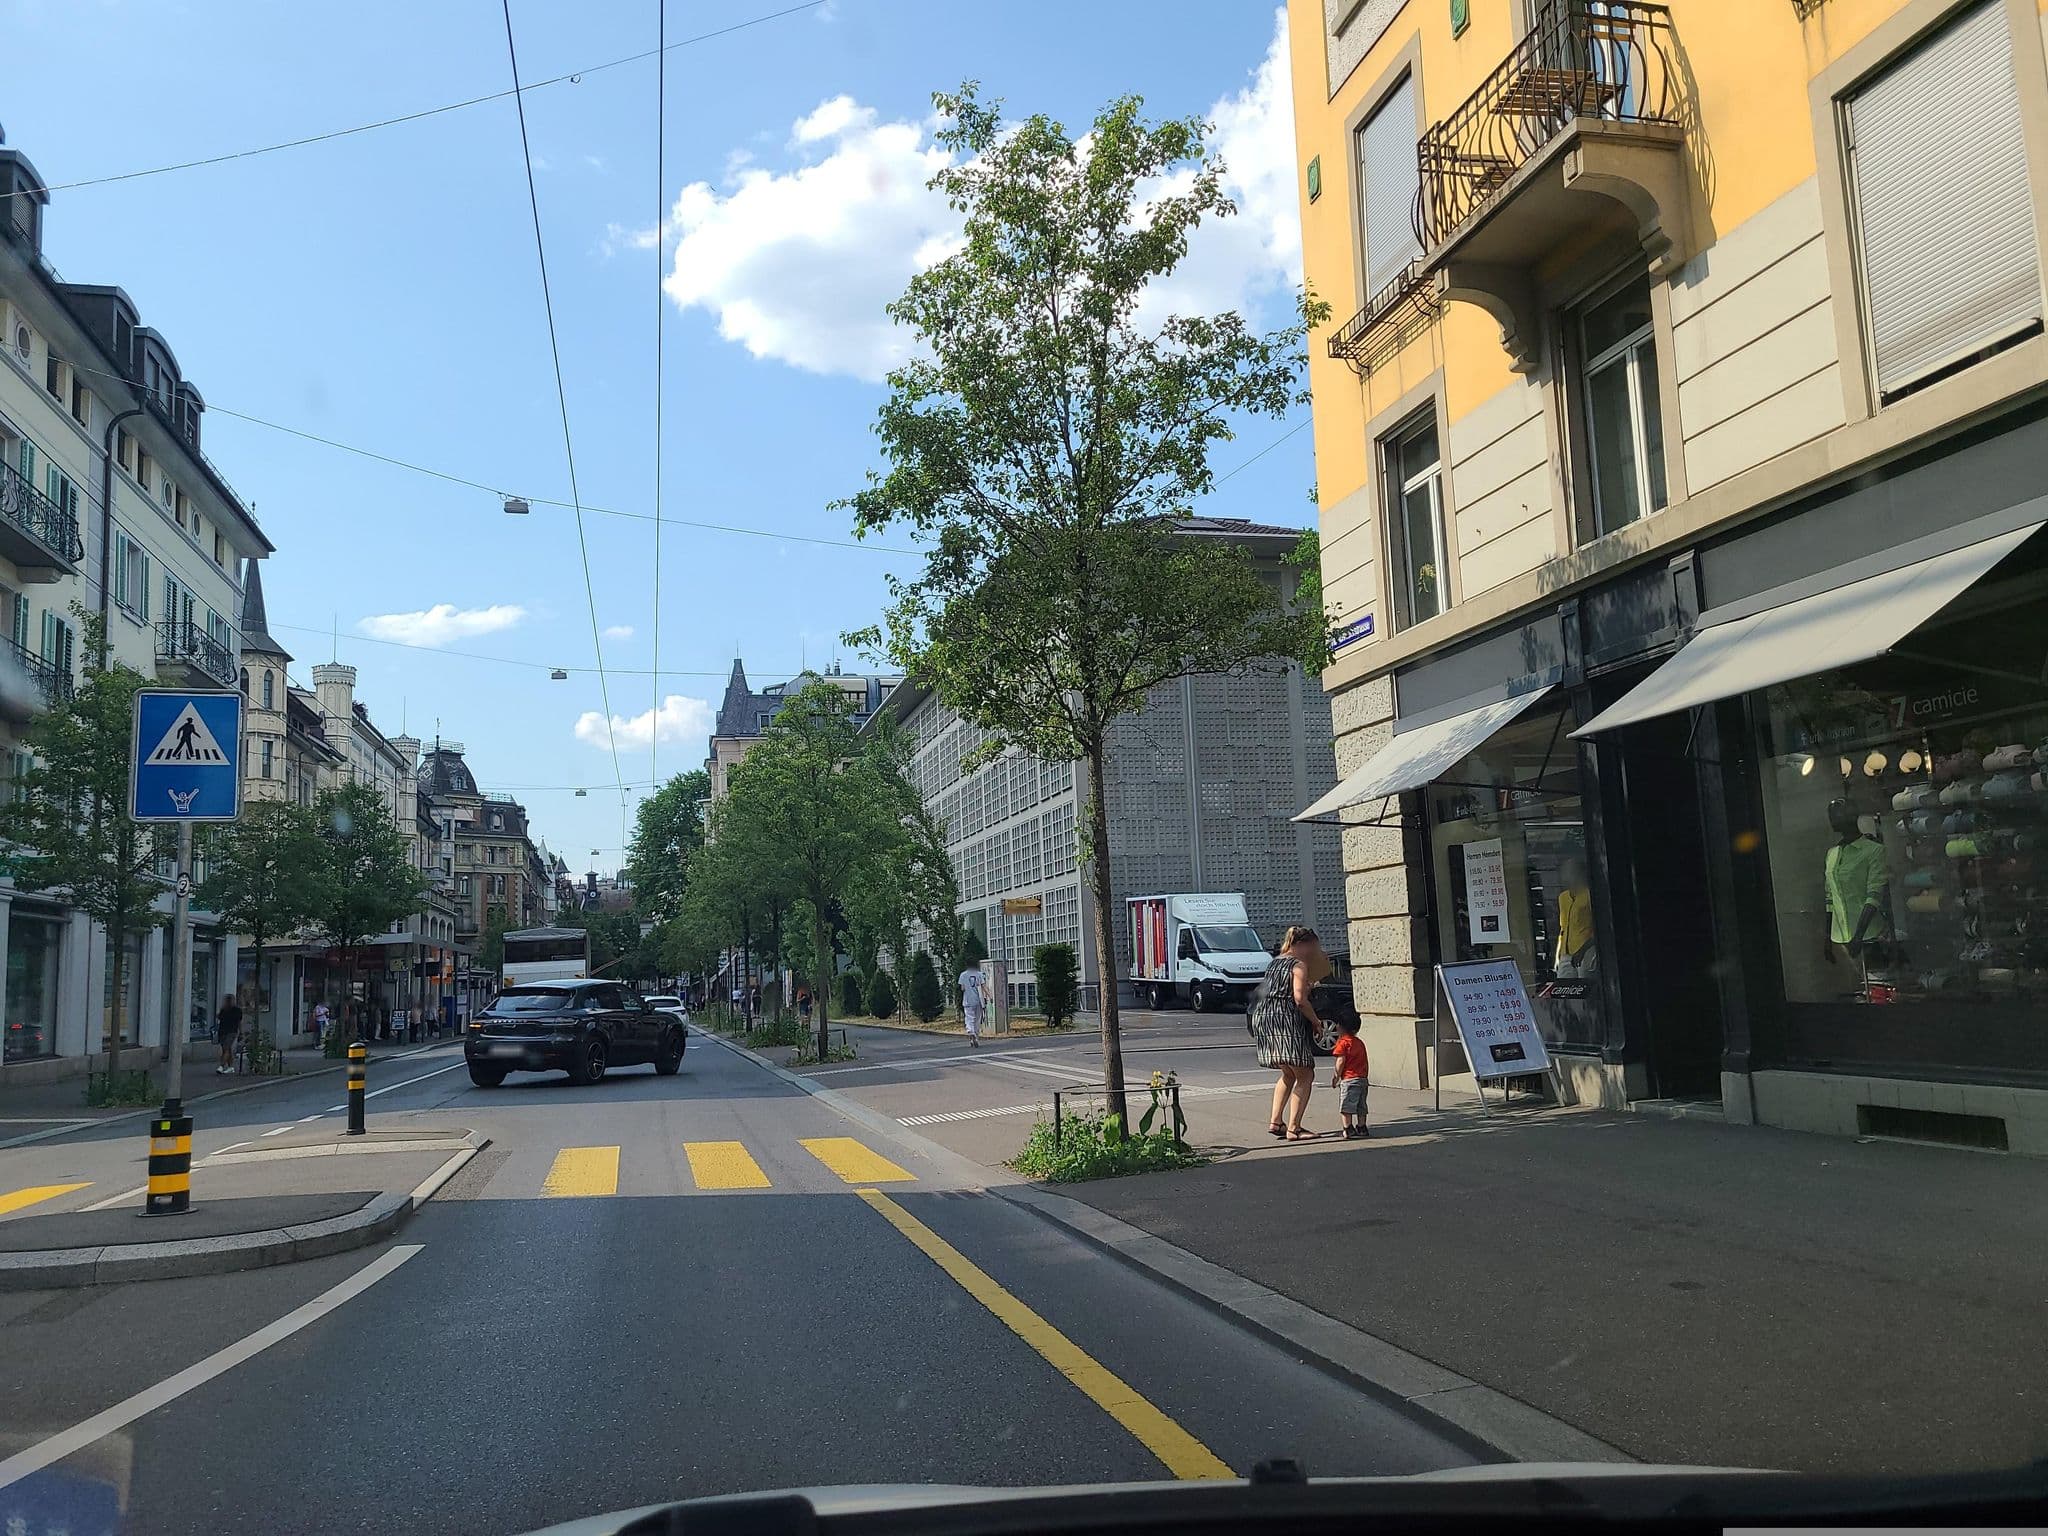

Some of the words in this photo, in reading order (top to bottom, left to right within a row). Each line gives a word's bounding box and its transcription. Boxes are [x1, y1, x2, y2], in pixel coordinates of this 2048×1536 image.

[1912, 687, 1979, 715] camicie
[1454, 976, 1483, 986] Damen
[1484, 973, 1514, 983] Blusen
[1463, 992, 1484, 1001] 94.90
[1494, 988, 1517, 997] 74.90
[1467, 1004, 1488, 1014] 89.90
[1500, 1000, 1522, 1010] 69.90
[1472, 1016, 1492, 1026] 79.90
[1504, 1012, 1526, 1022] 59.90
[1475, 1028, 1496, 1038] 69.90
[1508, 1024, 1530, 1034] 49.90
